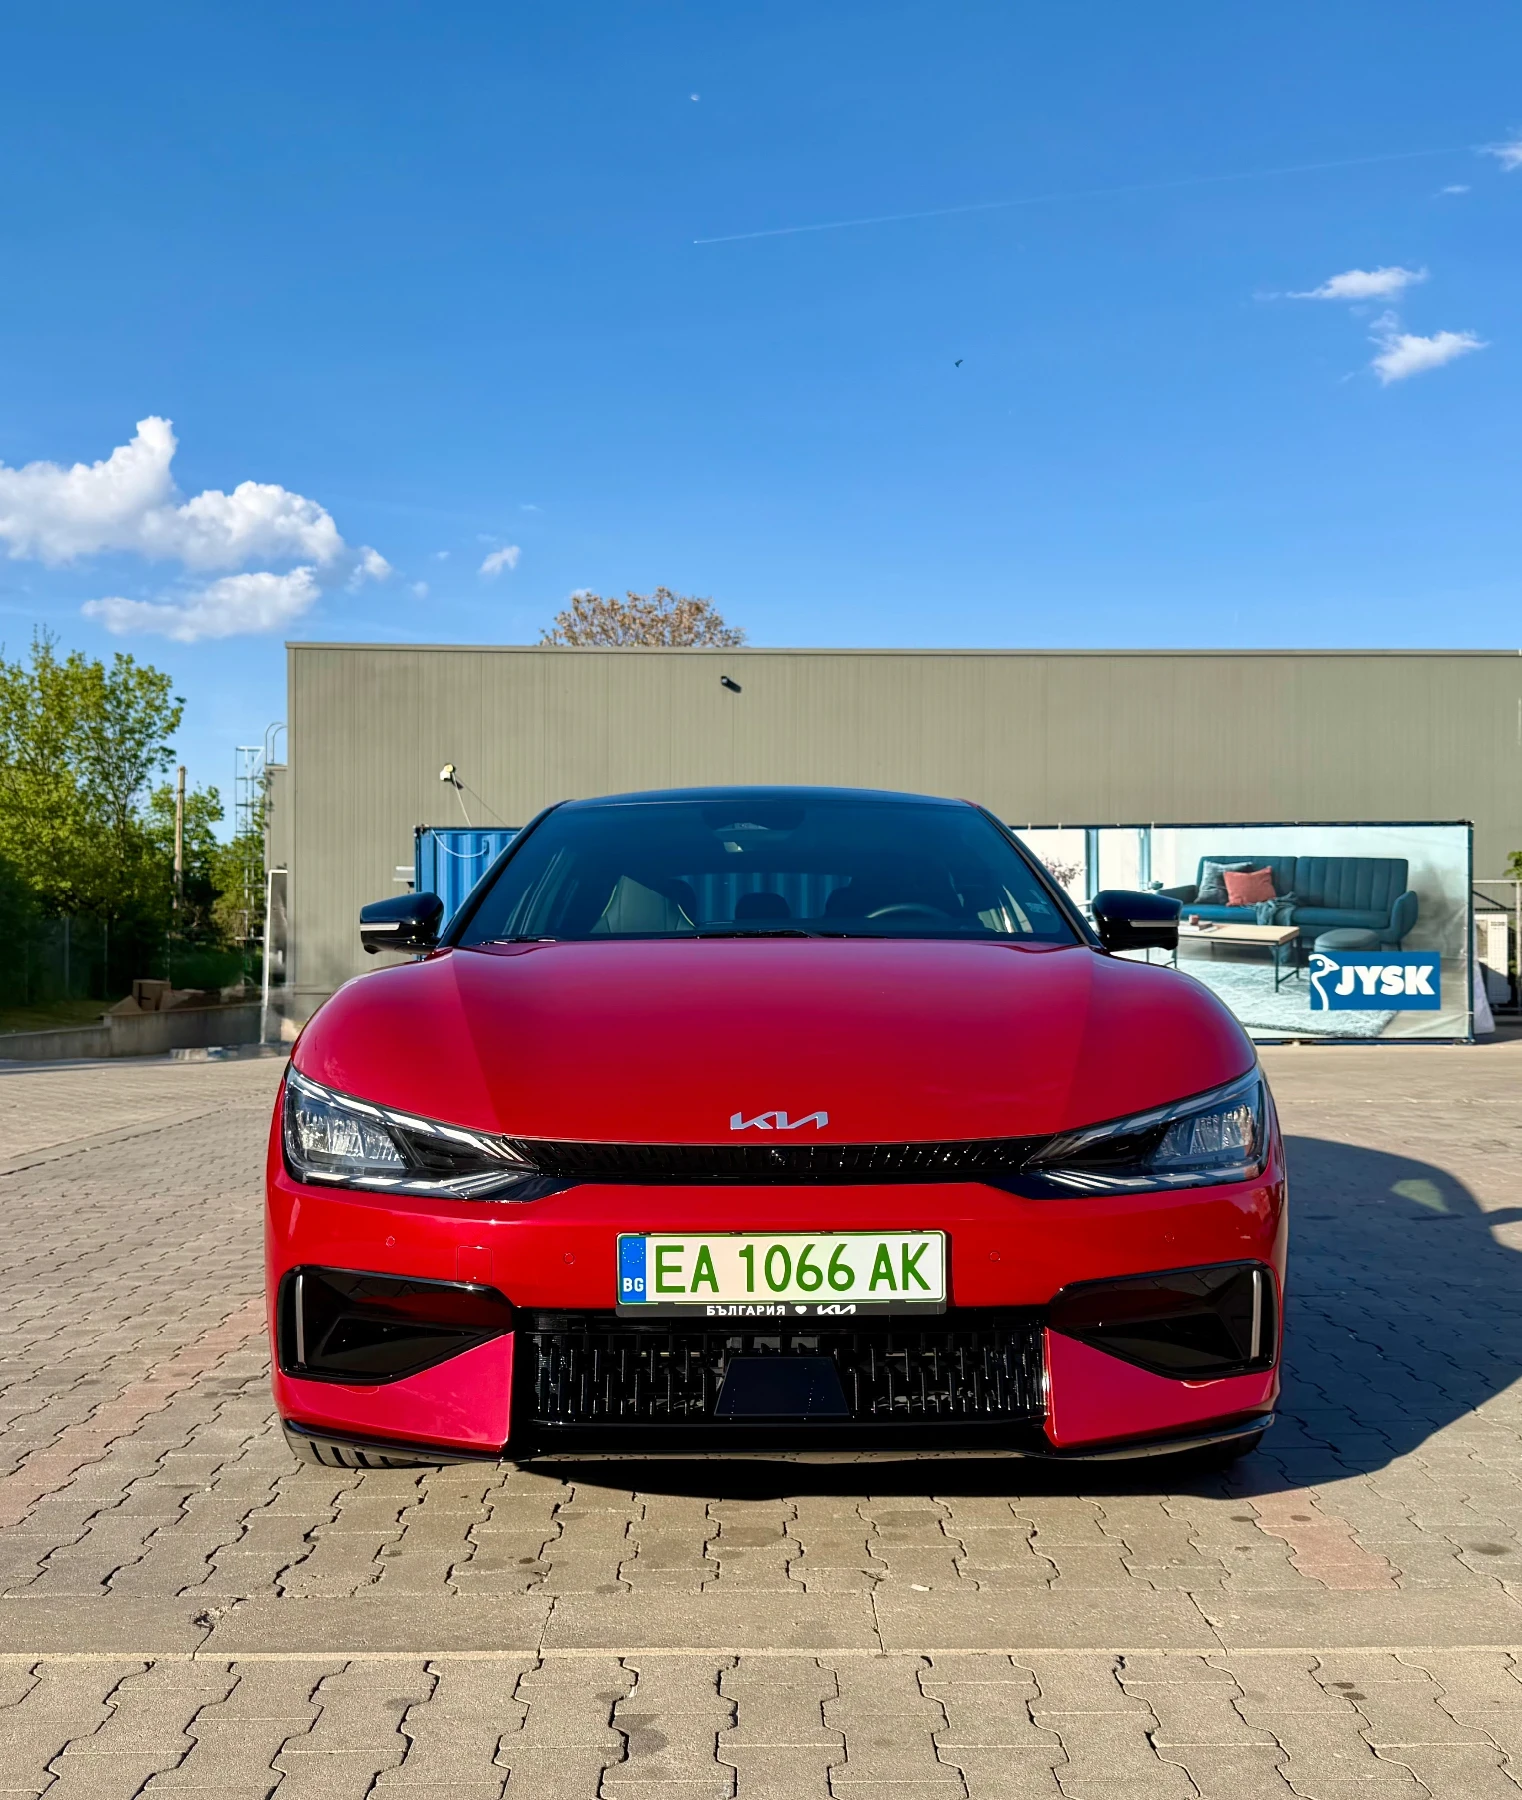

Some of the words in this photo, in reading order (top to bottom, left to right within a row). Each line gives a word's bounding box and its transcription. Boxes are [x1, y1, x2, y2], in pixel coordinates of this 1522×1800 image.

[1334, 965, 1436, 996] JYSK
[730, 1111, 829, 1130] KIA
[655, 1244, 720, 1293] EA
[738, 1243, 855, 1292] 1066
[868, 1242, 931, 1291] AK
[622, 1277, 645, 1293] BG
[706, 1305, 786, 1316] БЪЛГАРИЯ
